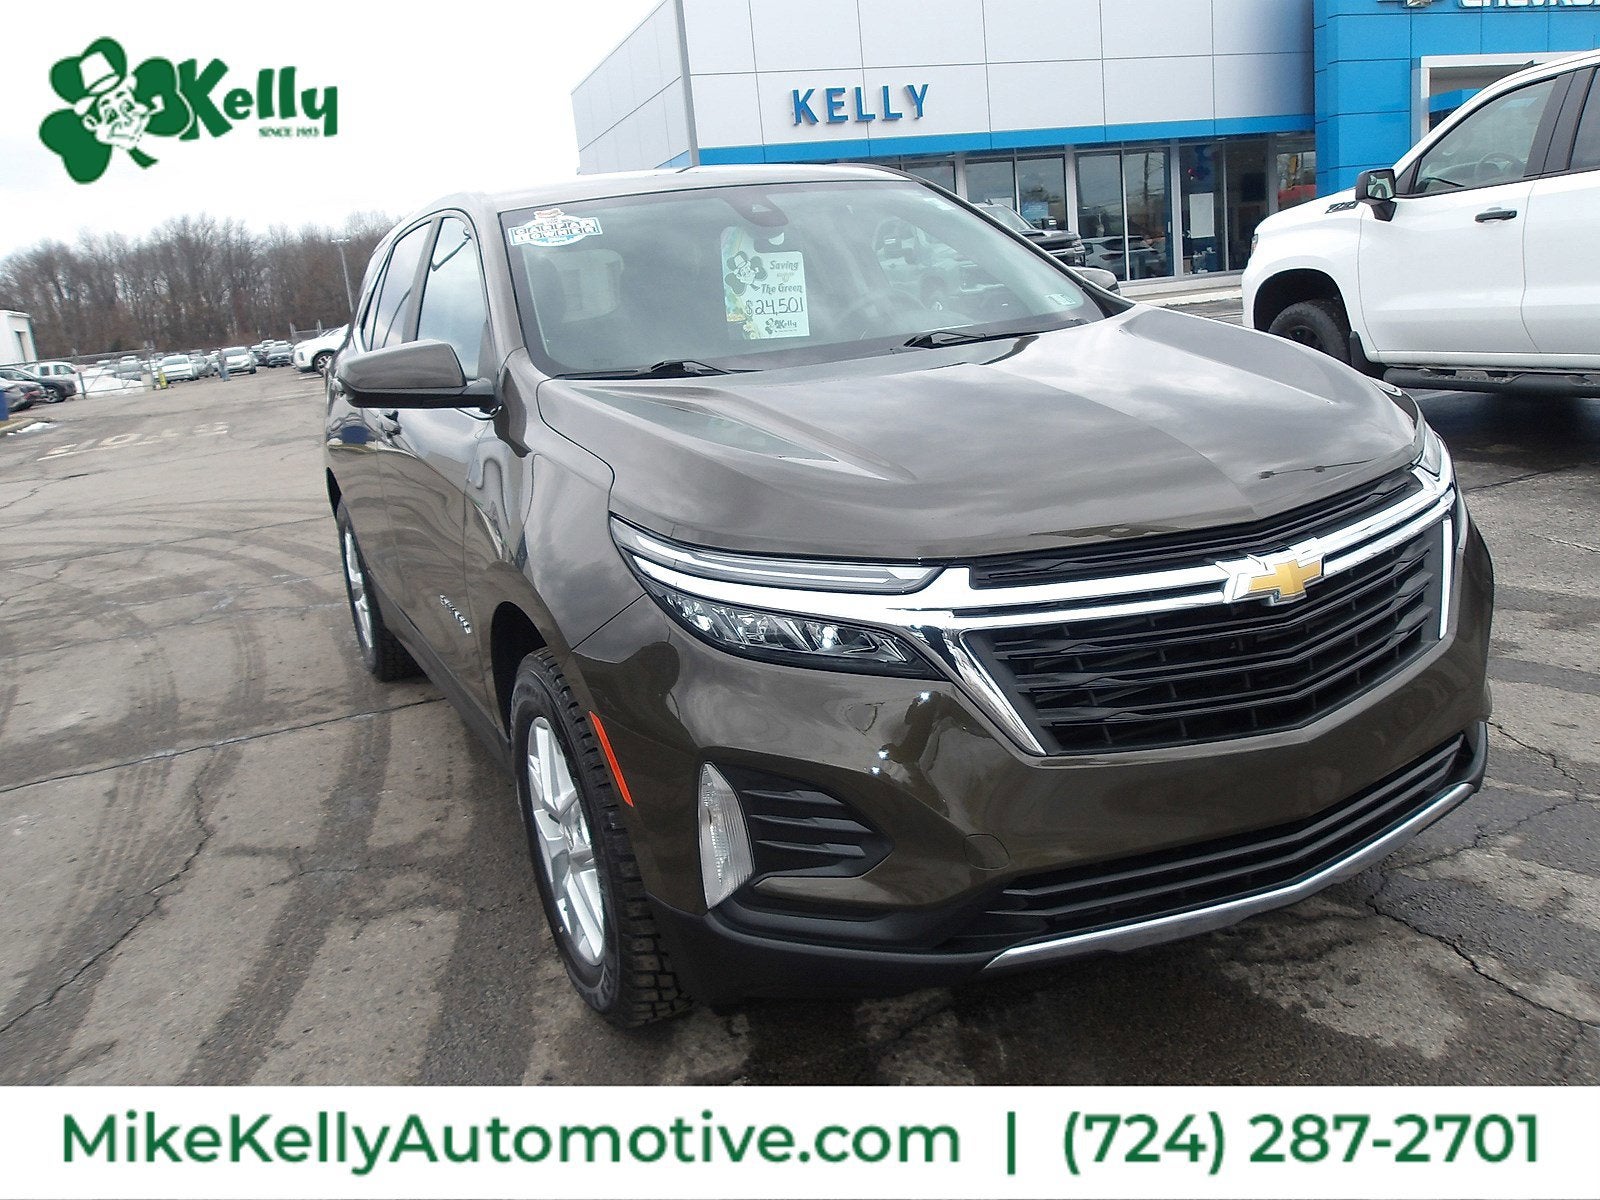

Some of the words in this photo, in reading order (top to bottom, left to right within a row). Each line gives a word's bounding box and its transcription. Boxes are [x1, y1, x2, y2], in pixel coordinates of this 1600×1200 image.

[791, 84, 929, 125] KELLY
[769, 260, 799, 271] Saving
[761, 284, 776, 295] The
[778, 283, 803, 294] Green
